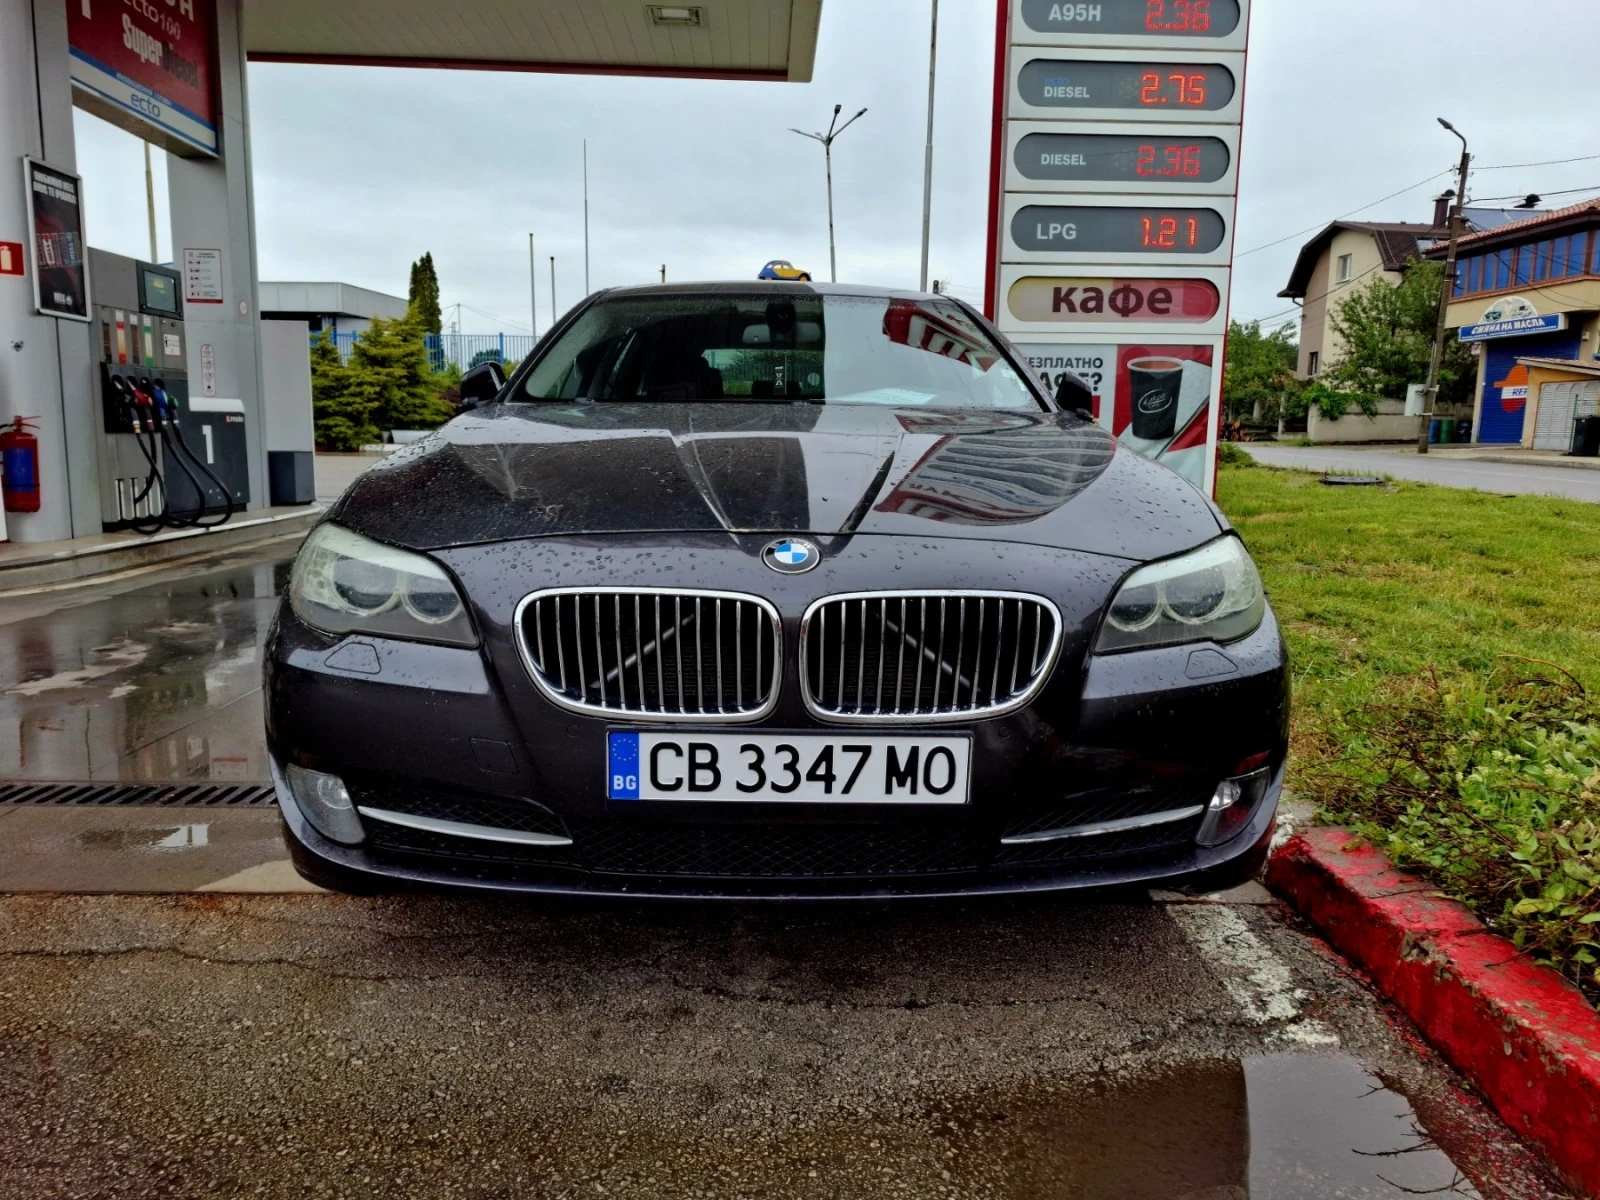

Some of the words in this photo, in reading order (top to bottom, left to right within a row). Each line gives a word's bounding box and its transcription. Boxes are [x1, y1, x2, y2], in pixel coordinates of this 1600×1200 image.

[1048, 4, 1101, 22] A95H
[1146, 0, 1210, 31] 2.36
[122, 13, 163, 66] Super
[1043, 86, 1090, 98] DIESEL
[1141, 74, 1206, 105] 2.75
[130, 93, 161, 118] ecto
[1040, 153, 1087, 166] DIESEL
[1136, 145, 1200, 176] 2.36
[1036, 223, 1077, 240] LPG
[1143, 217, 1197, 246] 1.21
[1052, 284, 1173, 317] кафе
[1471, 324, 1500, 335] СМЯНА
[1501, 322, 1513, 332] НА
[1514, 318, 1546, 330] МАСЛА
[1025, 356, 1104, 369] ЕЗПЛАТНО
[202, 425, 214, 464] 1
[650, 742, 722, 793] CB
[735, 744, 873, 794] 3347
[885, 745, 957, 795] MO
[613, 775, 637, 790] BG
